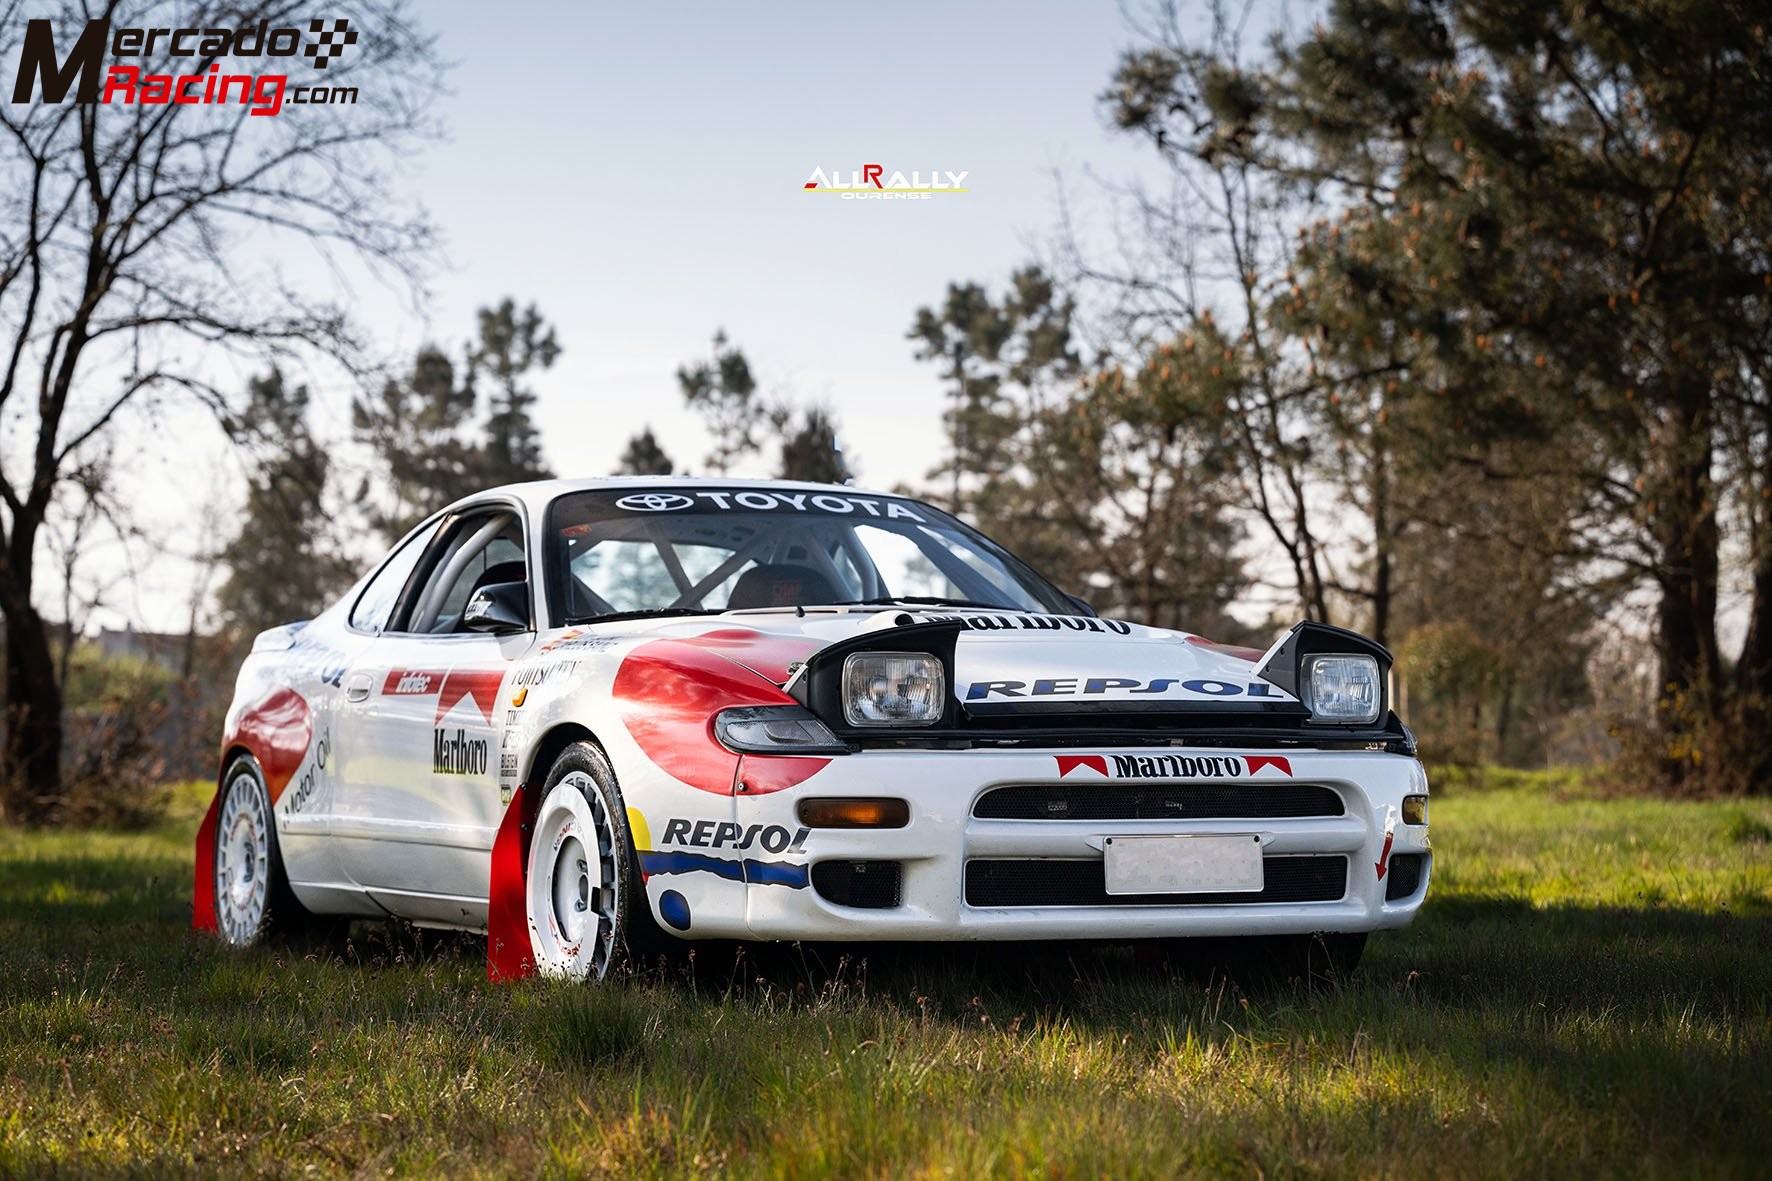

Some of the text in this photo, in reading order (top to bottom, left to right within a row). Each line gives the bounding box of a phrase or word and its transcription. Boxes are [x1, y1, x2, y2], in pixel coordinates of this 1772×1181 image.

[696, 492, 926, 522] TOYOTA
[965, 678, 1284, 699] REPSOL
[433, 728, 487, 775] Marlboro
[1108, 755, 1242, 778] Marlboro
[661, 818, 812, 855] REPSOL
